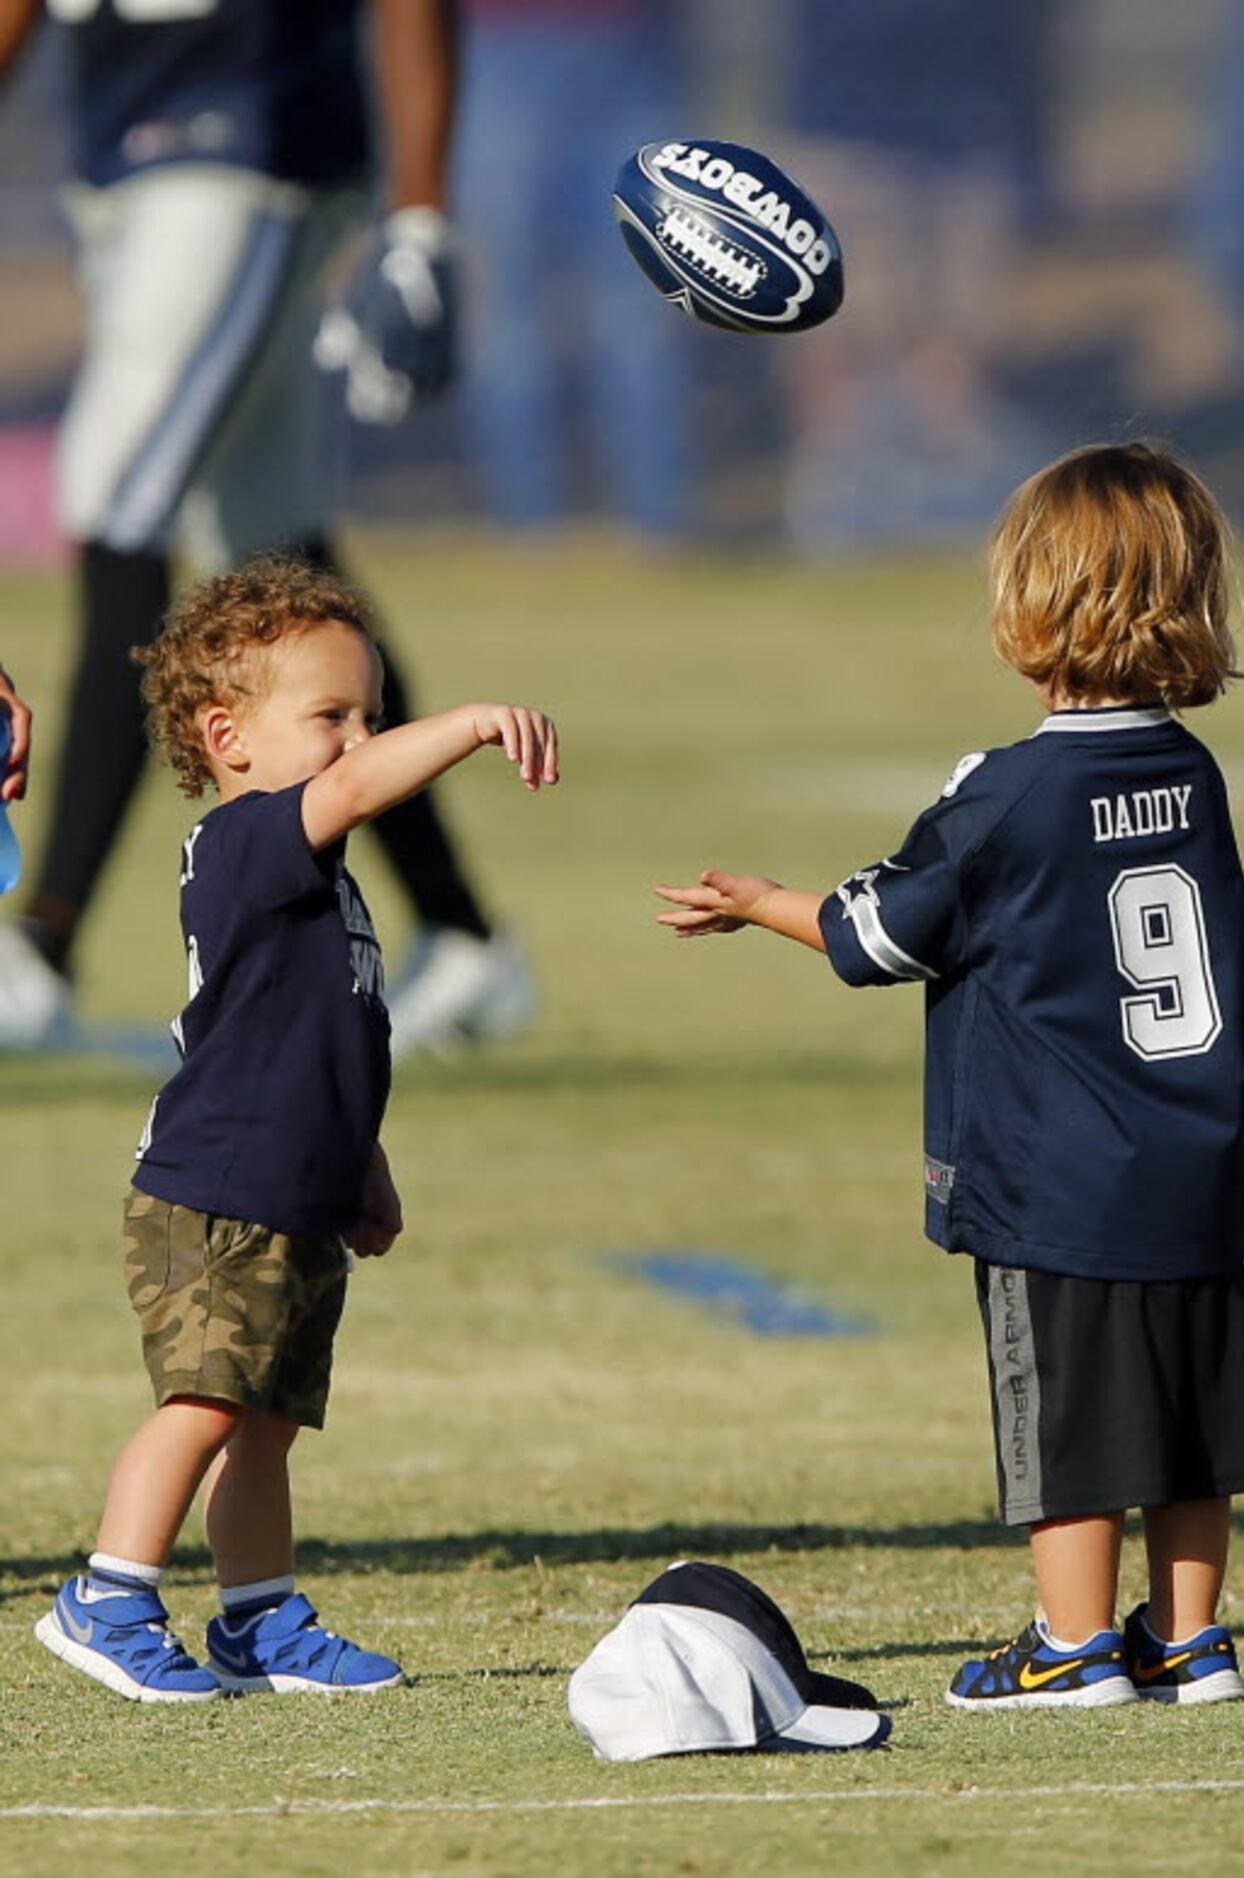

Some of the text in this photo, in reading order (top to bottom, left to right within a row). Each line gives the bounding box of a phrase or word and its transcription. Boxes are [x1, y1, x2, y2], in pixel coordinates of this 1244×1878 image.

[651, 142, 832, 275] COWBOYS
[1090, 784, 1193, 842] DADDY
[1107, 861, 1223, 1062] 9
[1008, 1374, 1029, 1480] UNDER
